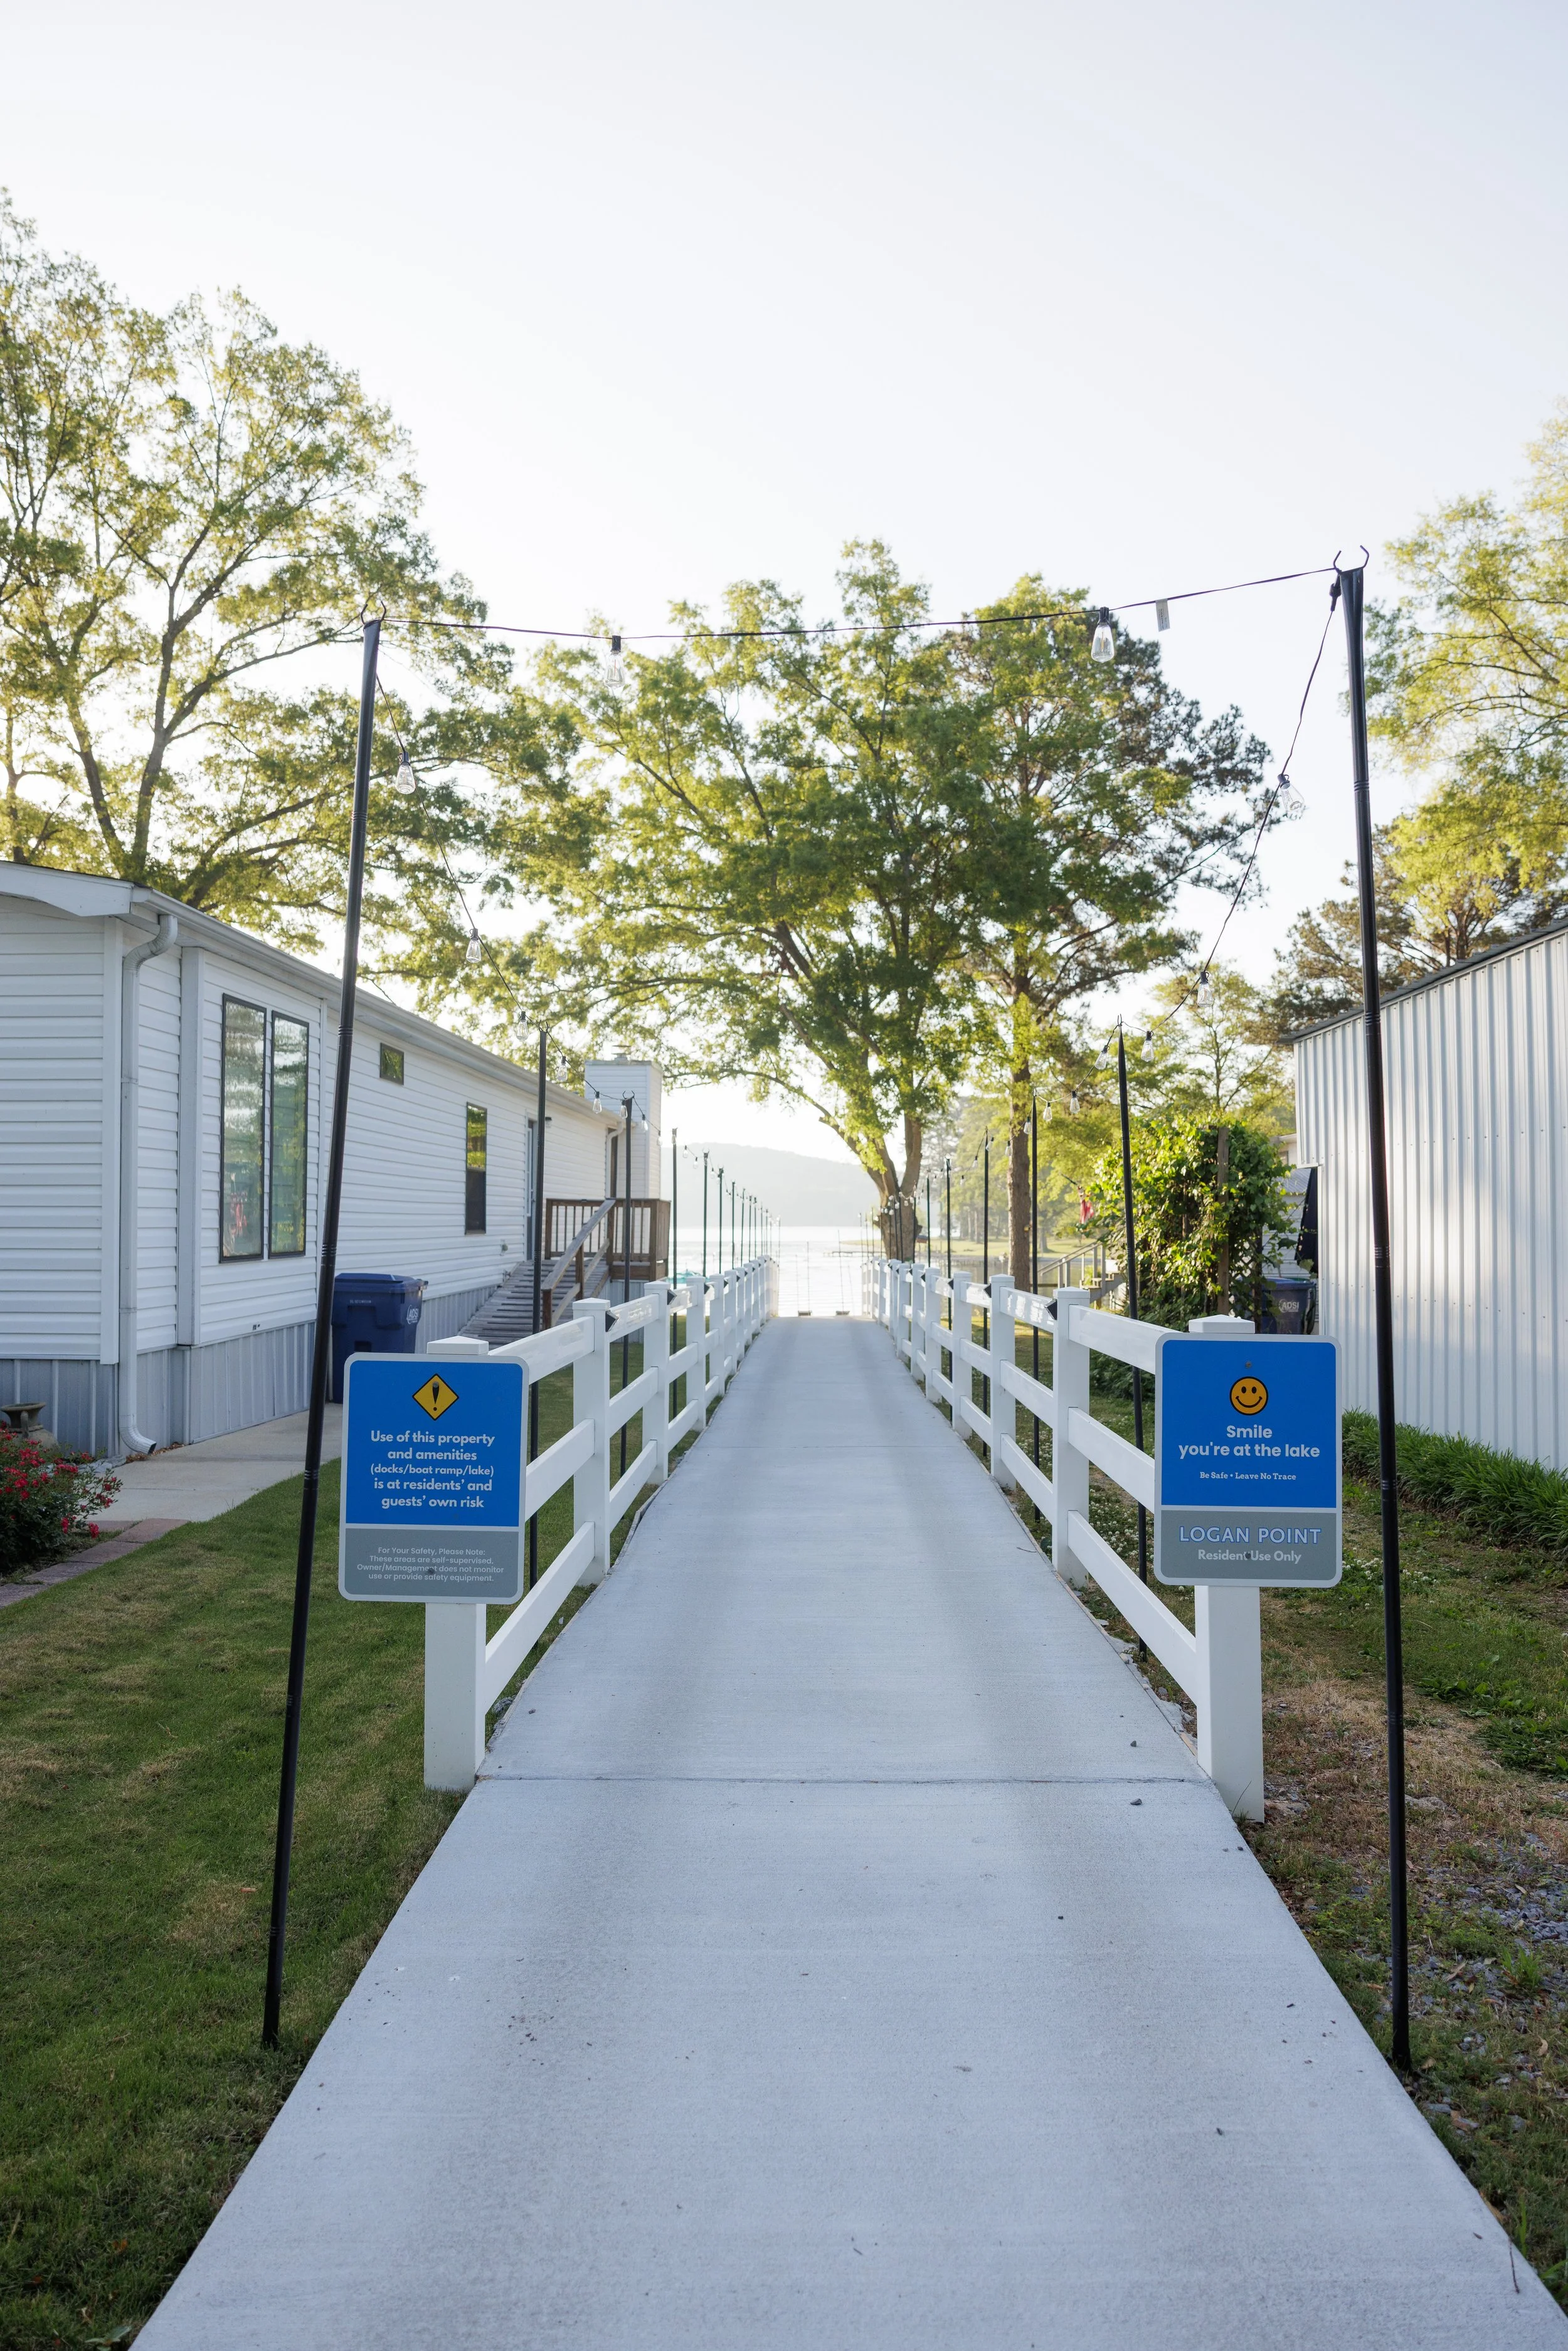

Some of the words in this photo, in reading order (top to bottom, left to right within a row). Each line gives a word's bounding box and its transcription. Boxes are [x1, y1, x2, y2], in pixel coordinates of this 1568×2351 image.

[371, 1430, 393, 1442] Use
[396, 1430, 410, 1442] of
[412, 1431, 435, 1443] this
[438, 1434, 495, 1446] property
[1226, 1425, 1273, 1438] Smile
[388, 1448, 413, 1459] and
[416, 1448, 477, 1460] amenities
[1179, 1441, 1230, 1459] you're
[1233, 1444, 1251, 1456] at
[1254, 1443, 1281, 1457] the
[1285, 1444, 1320, 1457] lake
[371, 1463, 433, 1475] (docks/boat
[435, 1465, 494, 1477] ramp/lake)
[374, 1477, 384, 1489] is
[386, 1479, 400, 1489] at
[467, 1479, 492, 1491] and
[428, 1498, 457, 1507] own
[460, 1496, 484, 1507] risk
[1179, 1526, 1250, 1543] LOGAN
[1258, 1527, 1322, 1544] POINT
[411, 1547, 437, 1556] Safety,
[1198, 1549, 1248, 1561] Resident
[1251, 1550, 1271, 1561] Use
[1274, 1550, 1302, 1564] Only
[432, 1556, 494, 1565] self-supervised.
[424, 1574, 448, 1582] safety
[450, 1574, 494, 1583] equipment.
